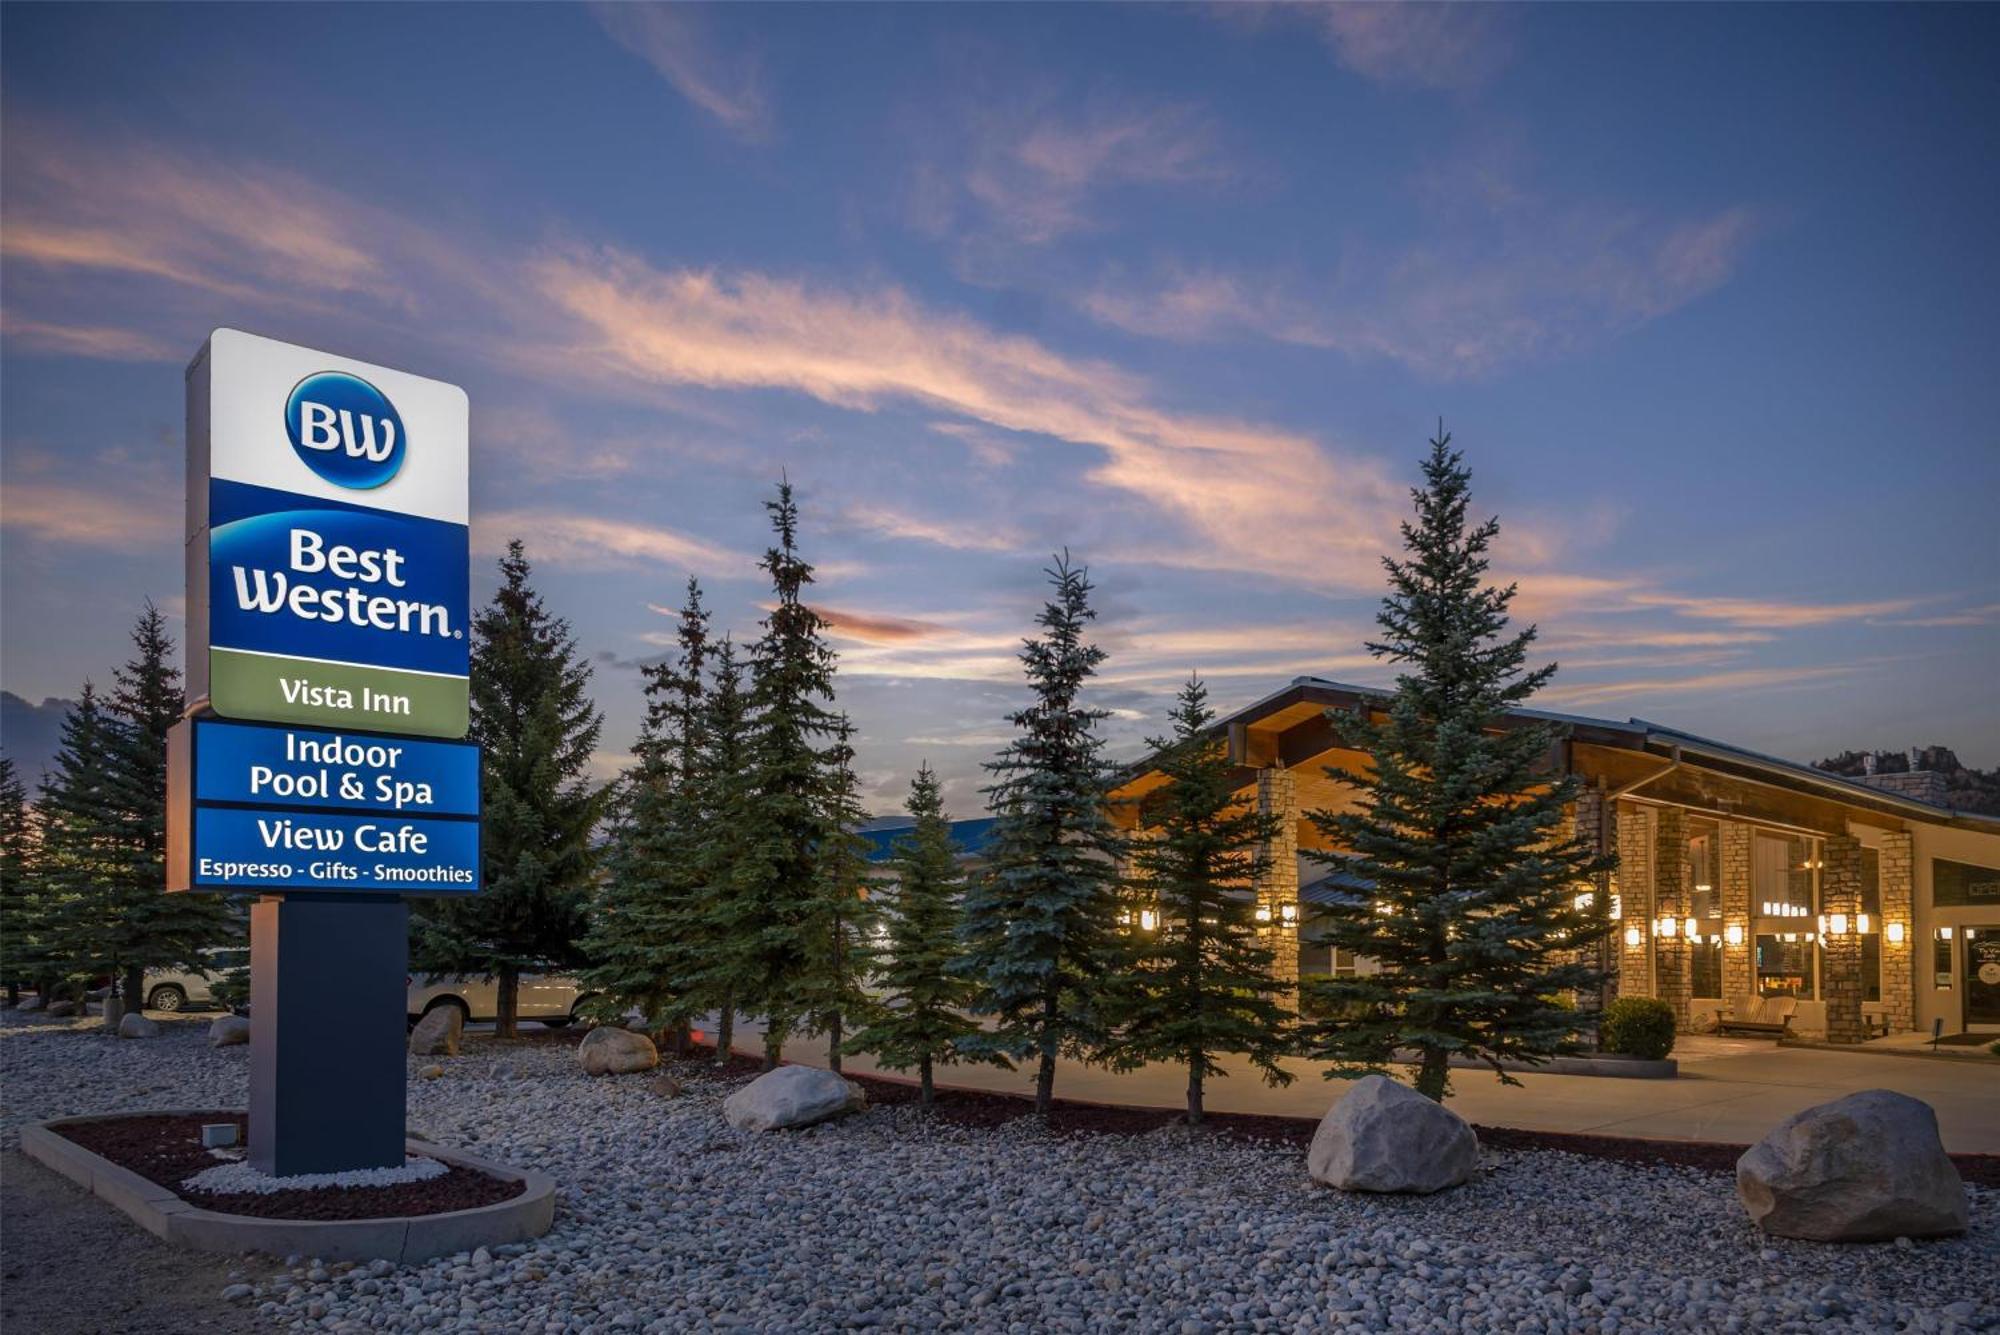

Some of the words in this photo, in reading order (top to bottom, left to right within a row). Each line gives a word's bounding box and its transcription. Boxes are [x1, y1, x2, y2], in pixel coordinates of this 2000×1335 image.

[300, 400, 396, 462] BW
[290, 529, 406, 587] Best
[232, 565, 453, 638] Western
[279, 678, 354, 709] Vista
[363, 687, 411, 715] Inn
[286, 733, 402, 768] Indoor
[250, 766, 329, 798] Pool
[339, 772, 366, 800] &
[375, 775, 434, 809] Spa
[257, 819, 344, 850] View
[354, 825, 428, 854] Cafe
[199, 858, 292, 880] Espresso
[309, 861, 358, 880] Gifts
[374, 864, 473, 883] Smoothies
